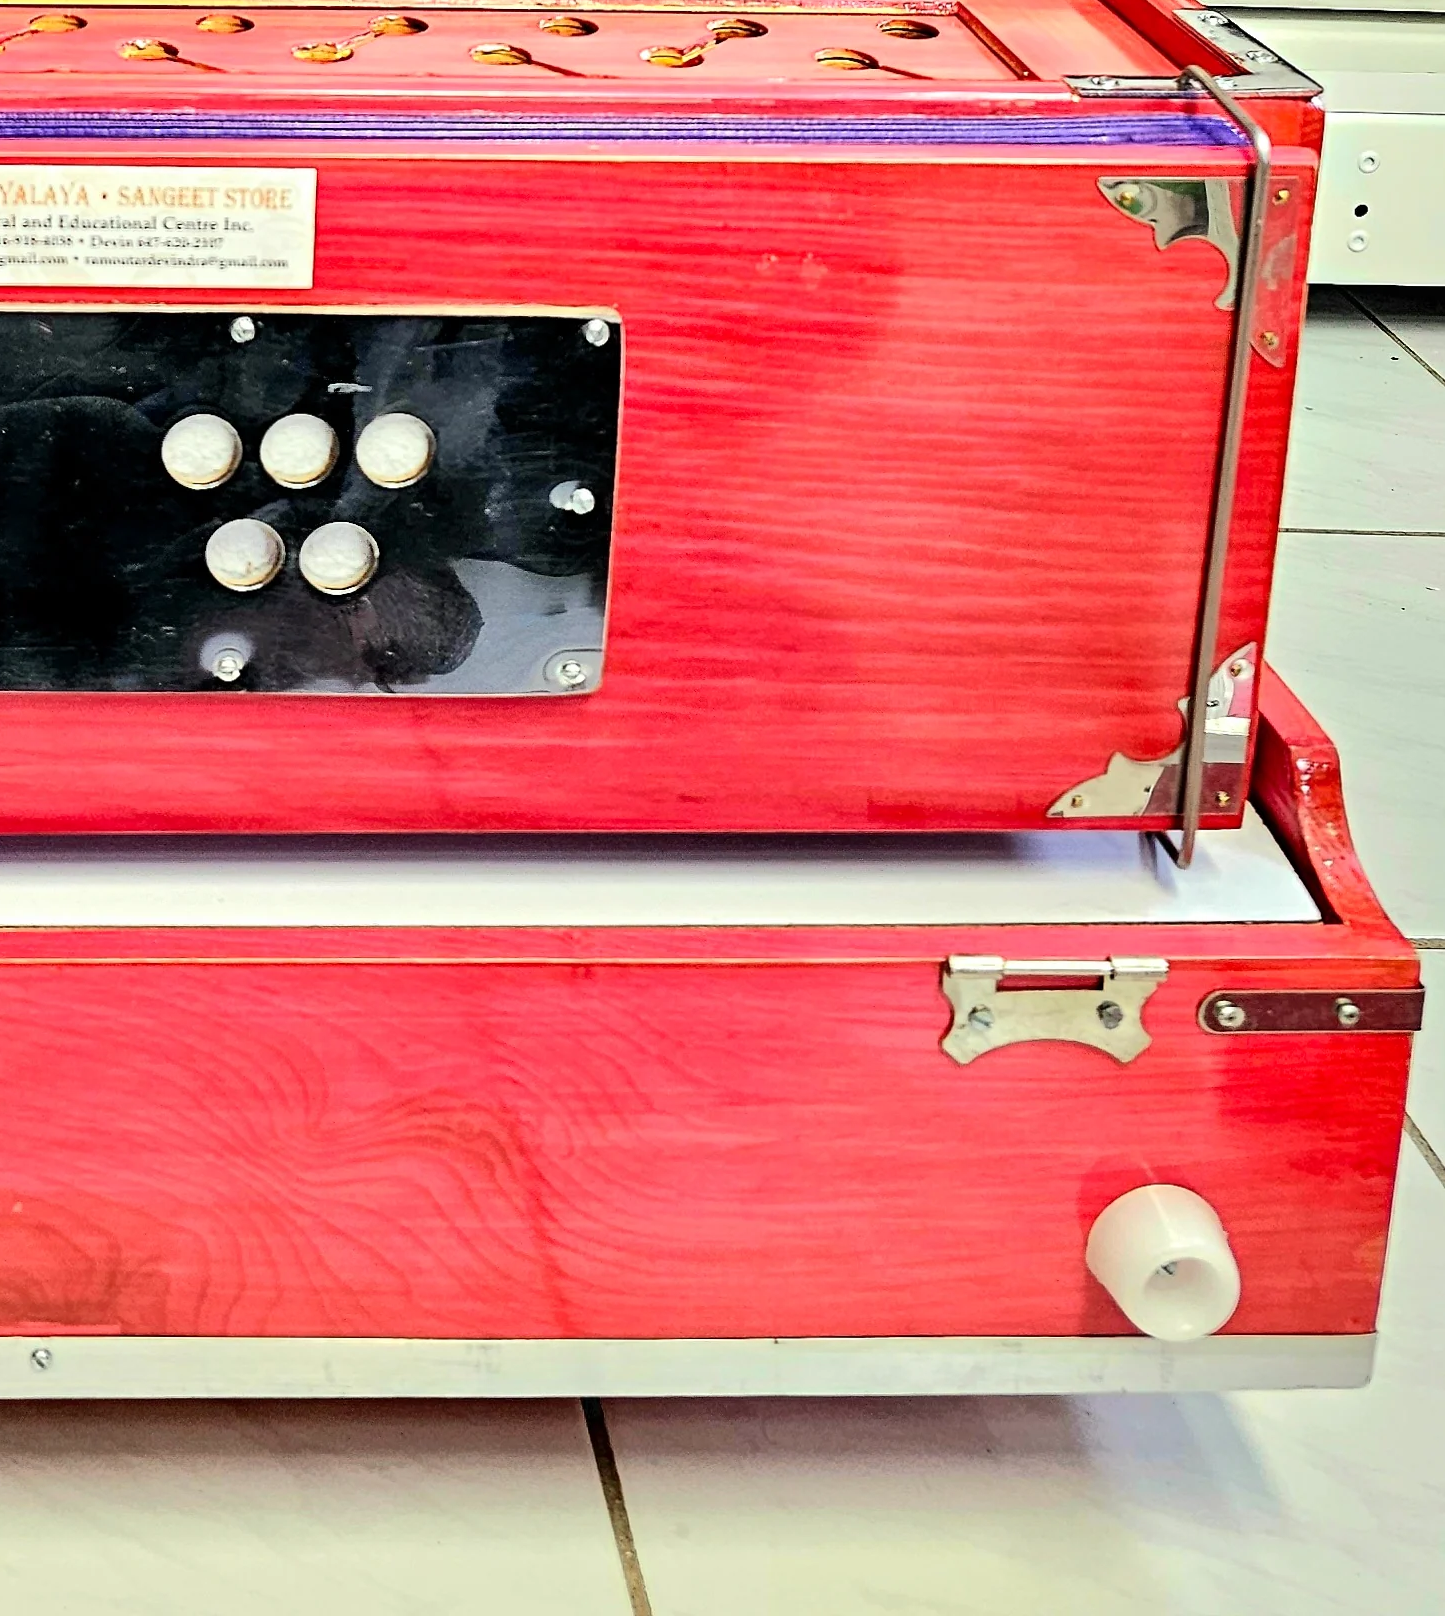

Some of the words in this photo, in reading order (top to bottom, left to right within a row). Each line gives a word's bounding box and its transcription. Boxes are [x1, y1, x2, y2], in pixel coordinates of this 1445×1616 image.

[116, 185, 220, 208] SANGEET
[223, 187, 293, 210] STORE
[22, 214, 52, 228] and
[58, 214, 157, 230] Educational
[163, 215, 218, 231] Centre
[224, 216, 255, 232] Inc.
[90, 235, 133, 247] Devin
